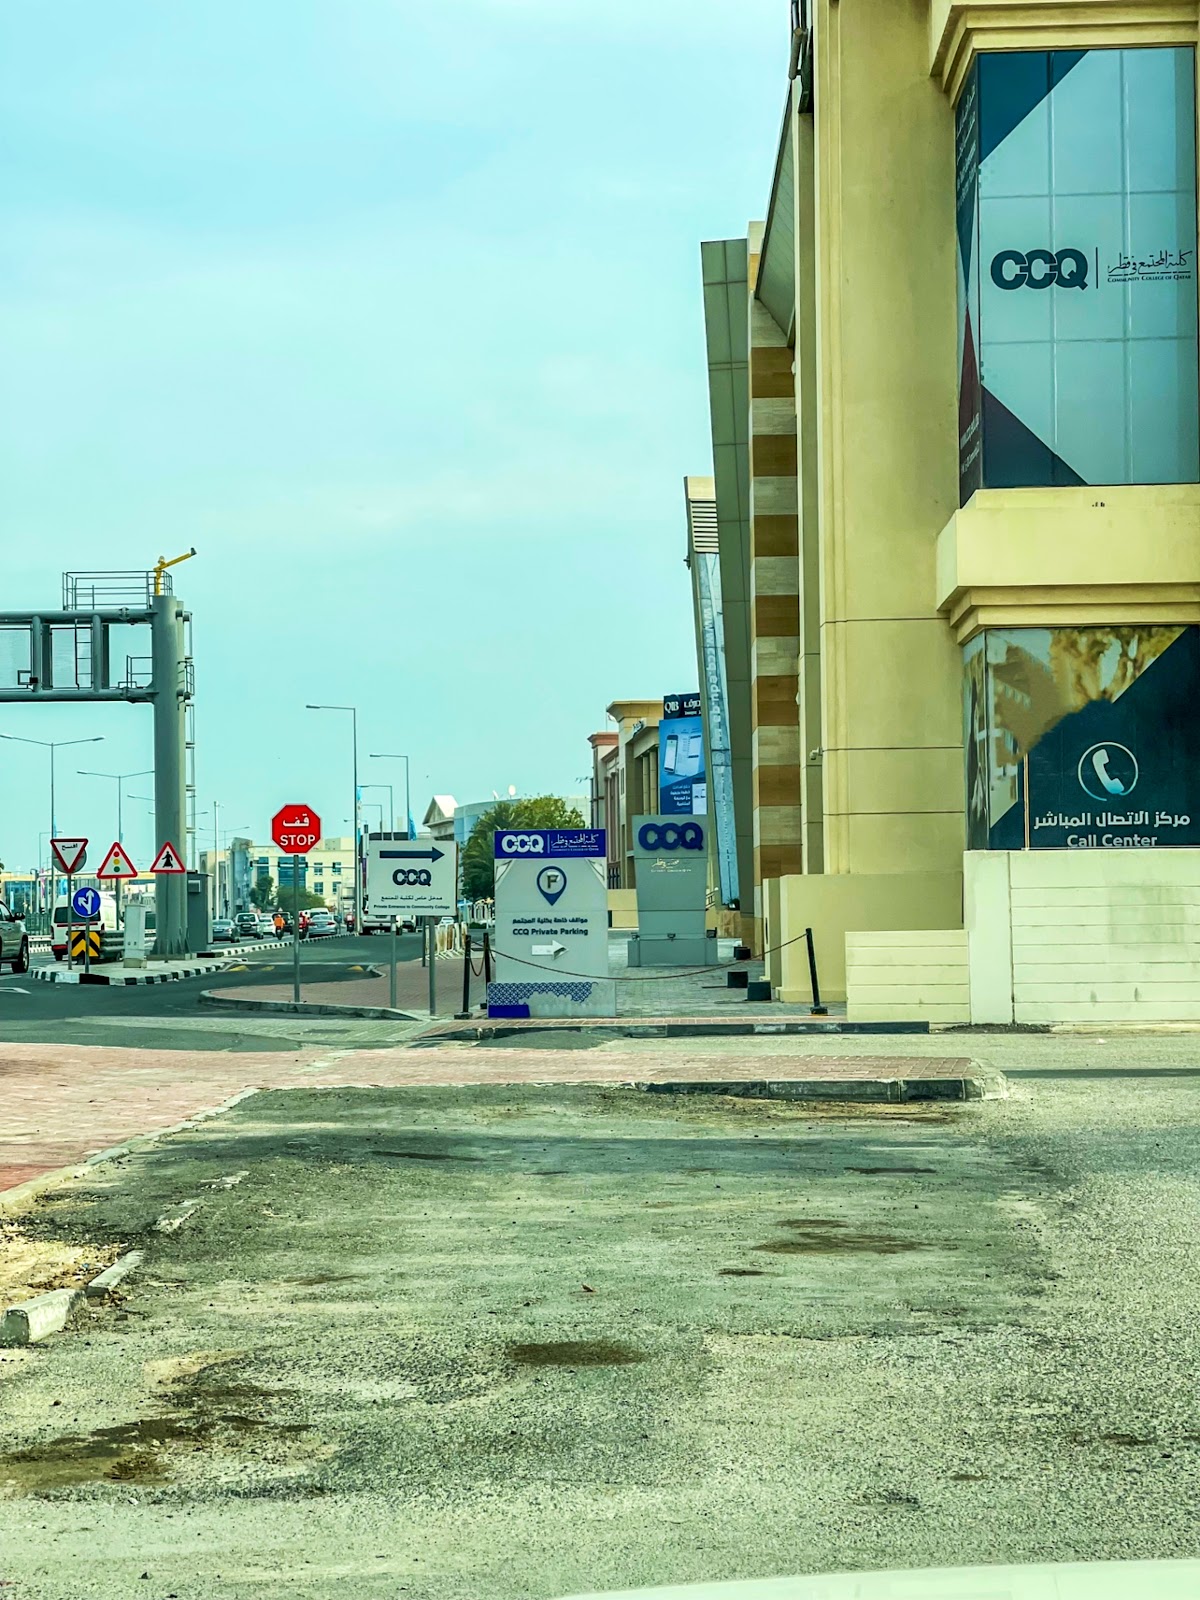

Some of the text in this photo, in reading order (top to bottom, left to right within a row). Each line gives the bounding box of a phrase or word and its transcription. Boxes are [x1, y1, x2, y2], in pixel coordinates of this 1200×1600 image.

[990, 248, 1088, 290] CCQ
[703, 607, 721, 723] www.ccq.edu.qa
[665, 701, 679, 713] QIB
[282, 813, 309, 827] قف
[1033, 811, 1191, 830] مركز الاتصال المباشر
[280, 834, 315, 846] STOP
[501, 834, 544, 853] CCQ
[638, 821, 704, 851] CCQ
[1067, 833, 1158, 847] Call Center
[392, 868, 432, 887] CCQ
[512, 928, 530, 936] CCQ
[560, 927, 588, 936] Parking
